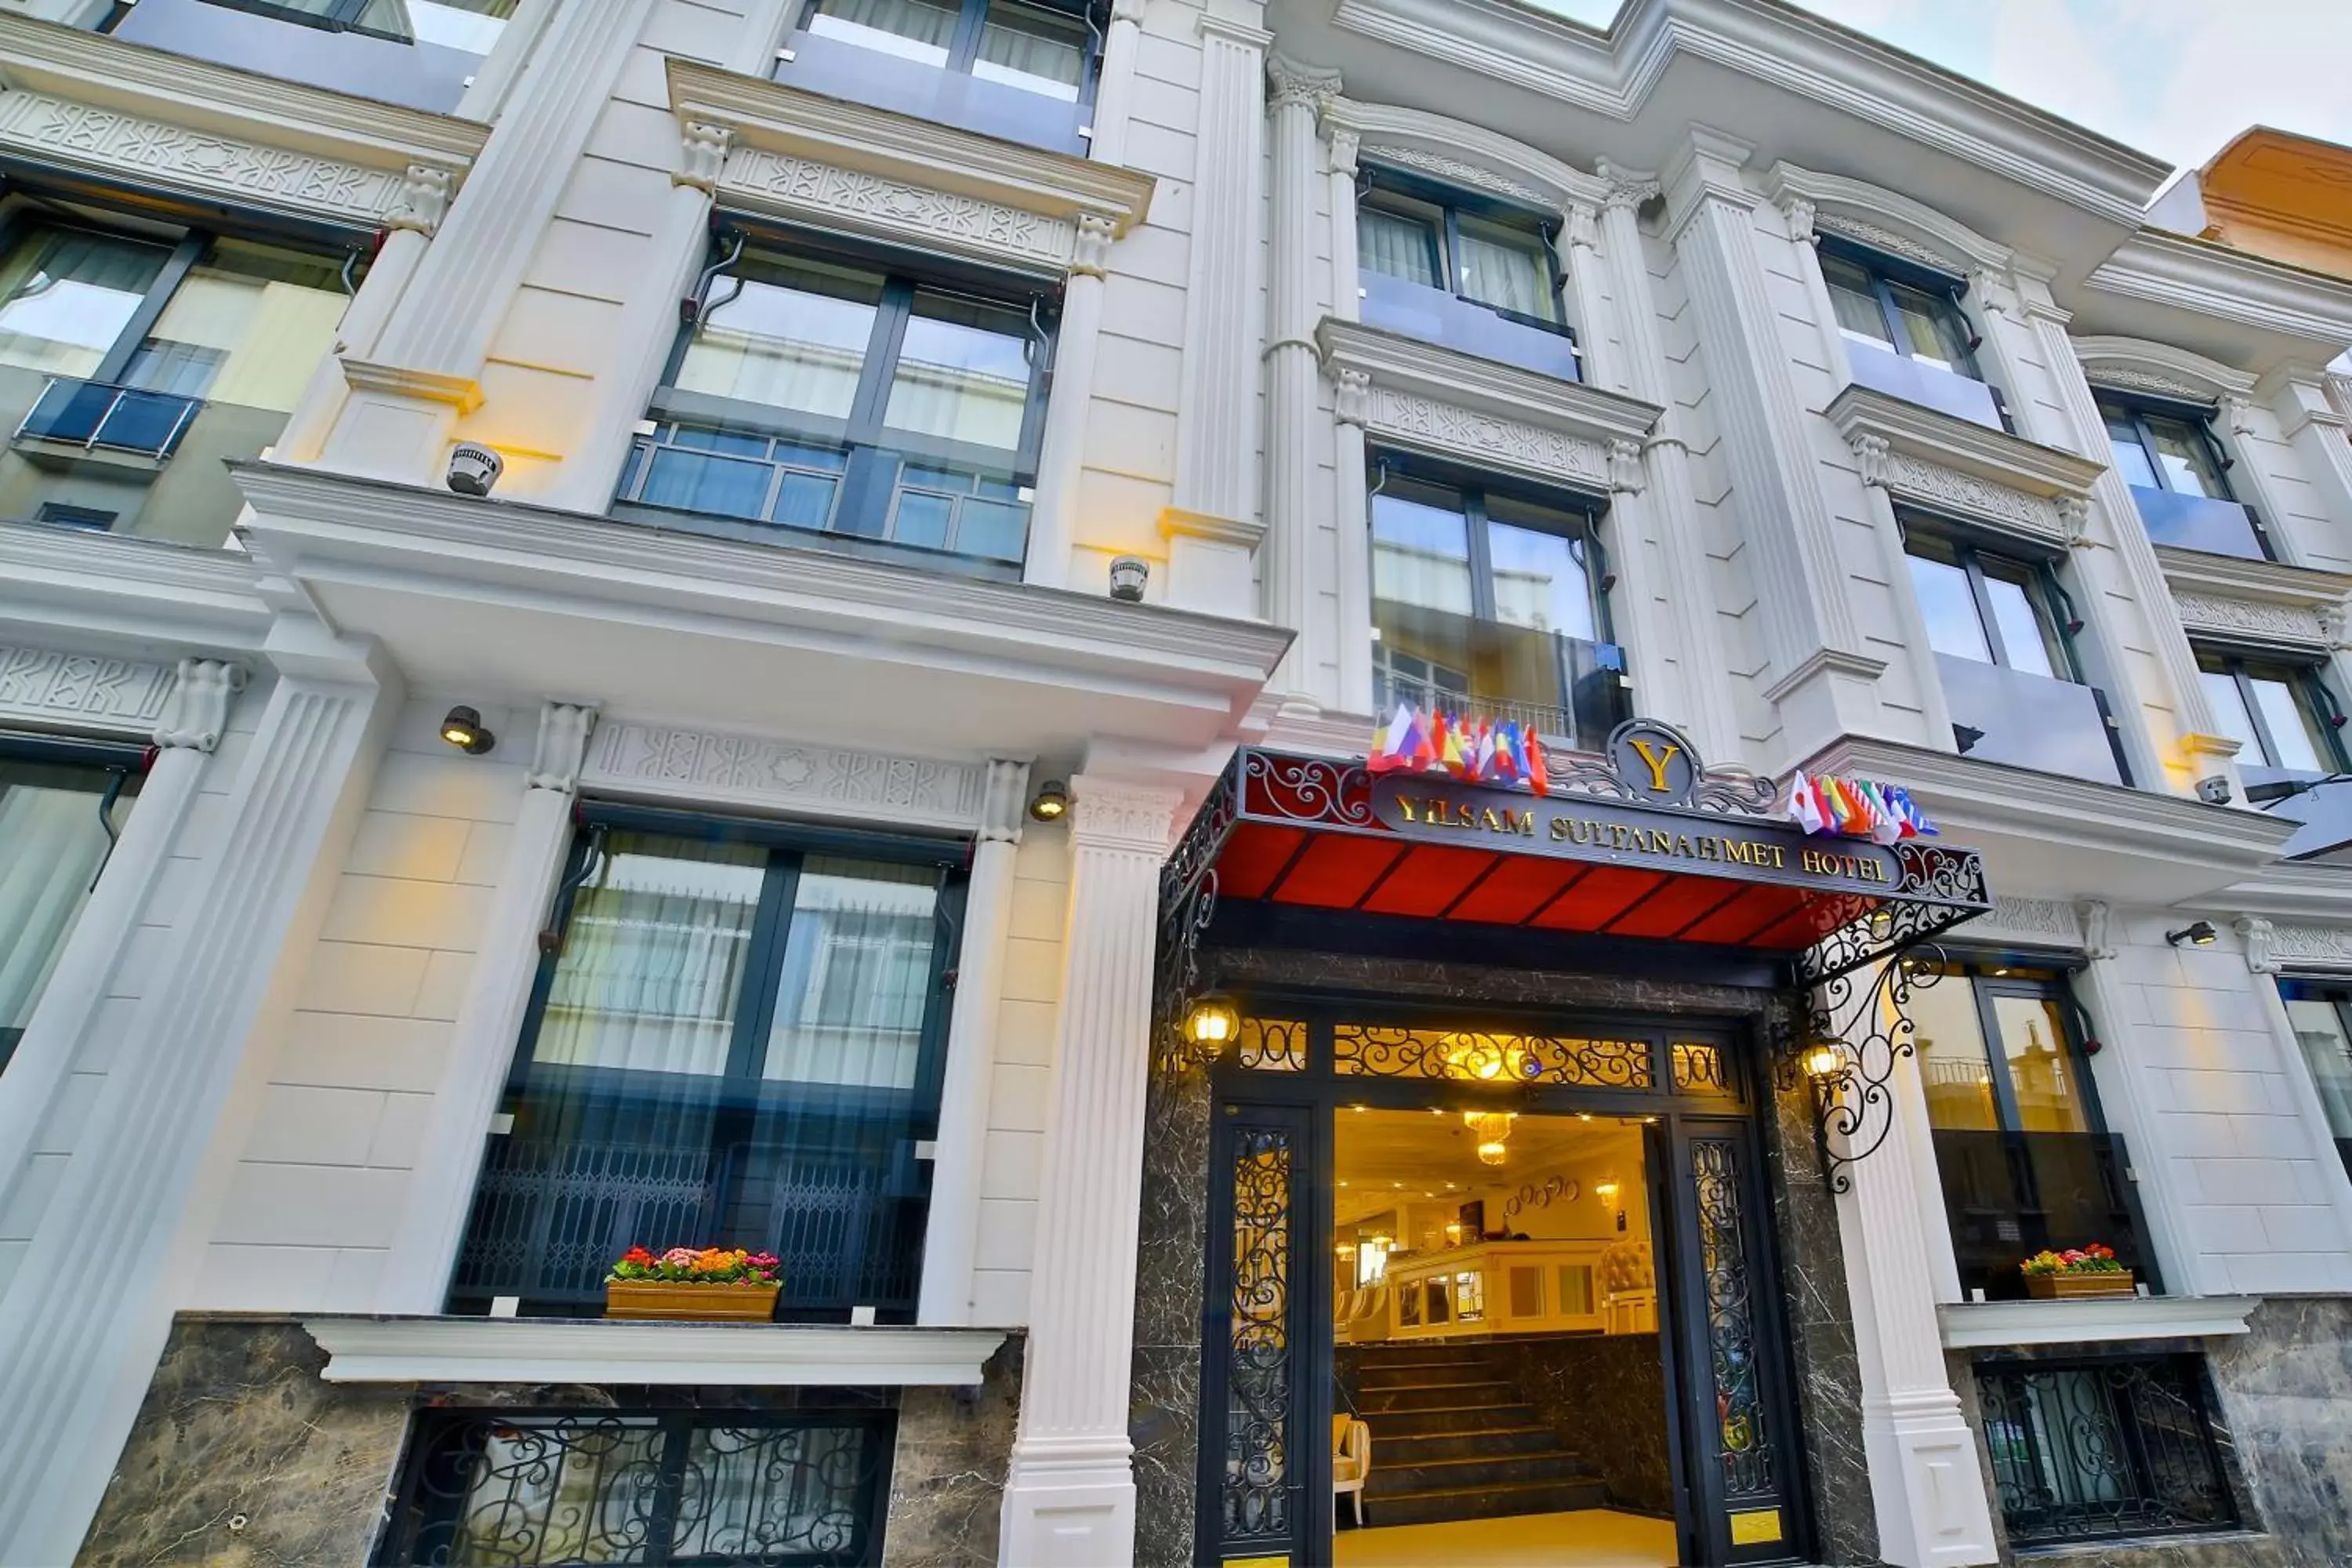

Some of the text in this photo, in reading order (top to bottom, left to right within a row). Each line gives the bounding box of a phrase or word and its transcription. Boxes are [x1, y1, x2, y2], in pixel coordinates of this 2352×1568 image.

[1628, 739, 1679, 792] Y
[1396, 794, 1892, 883] YILSAM SULTANAHMET HOTEL
